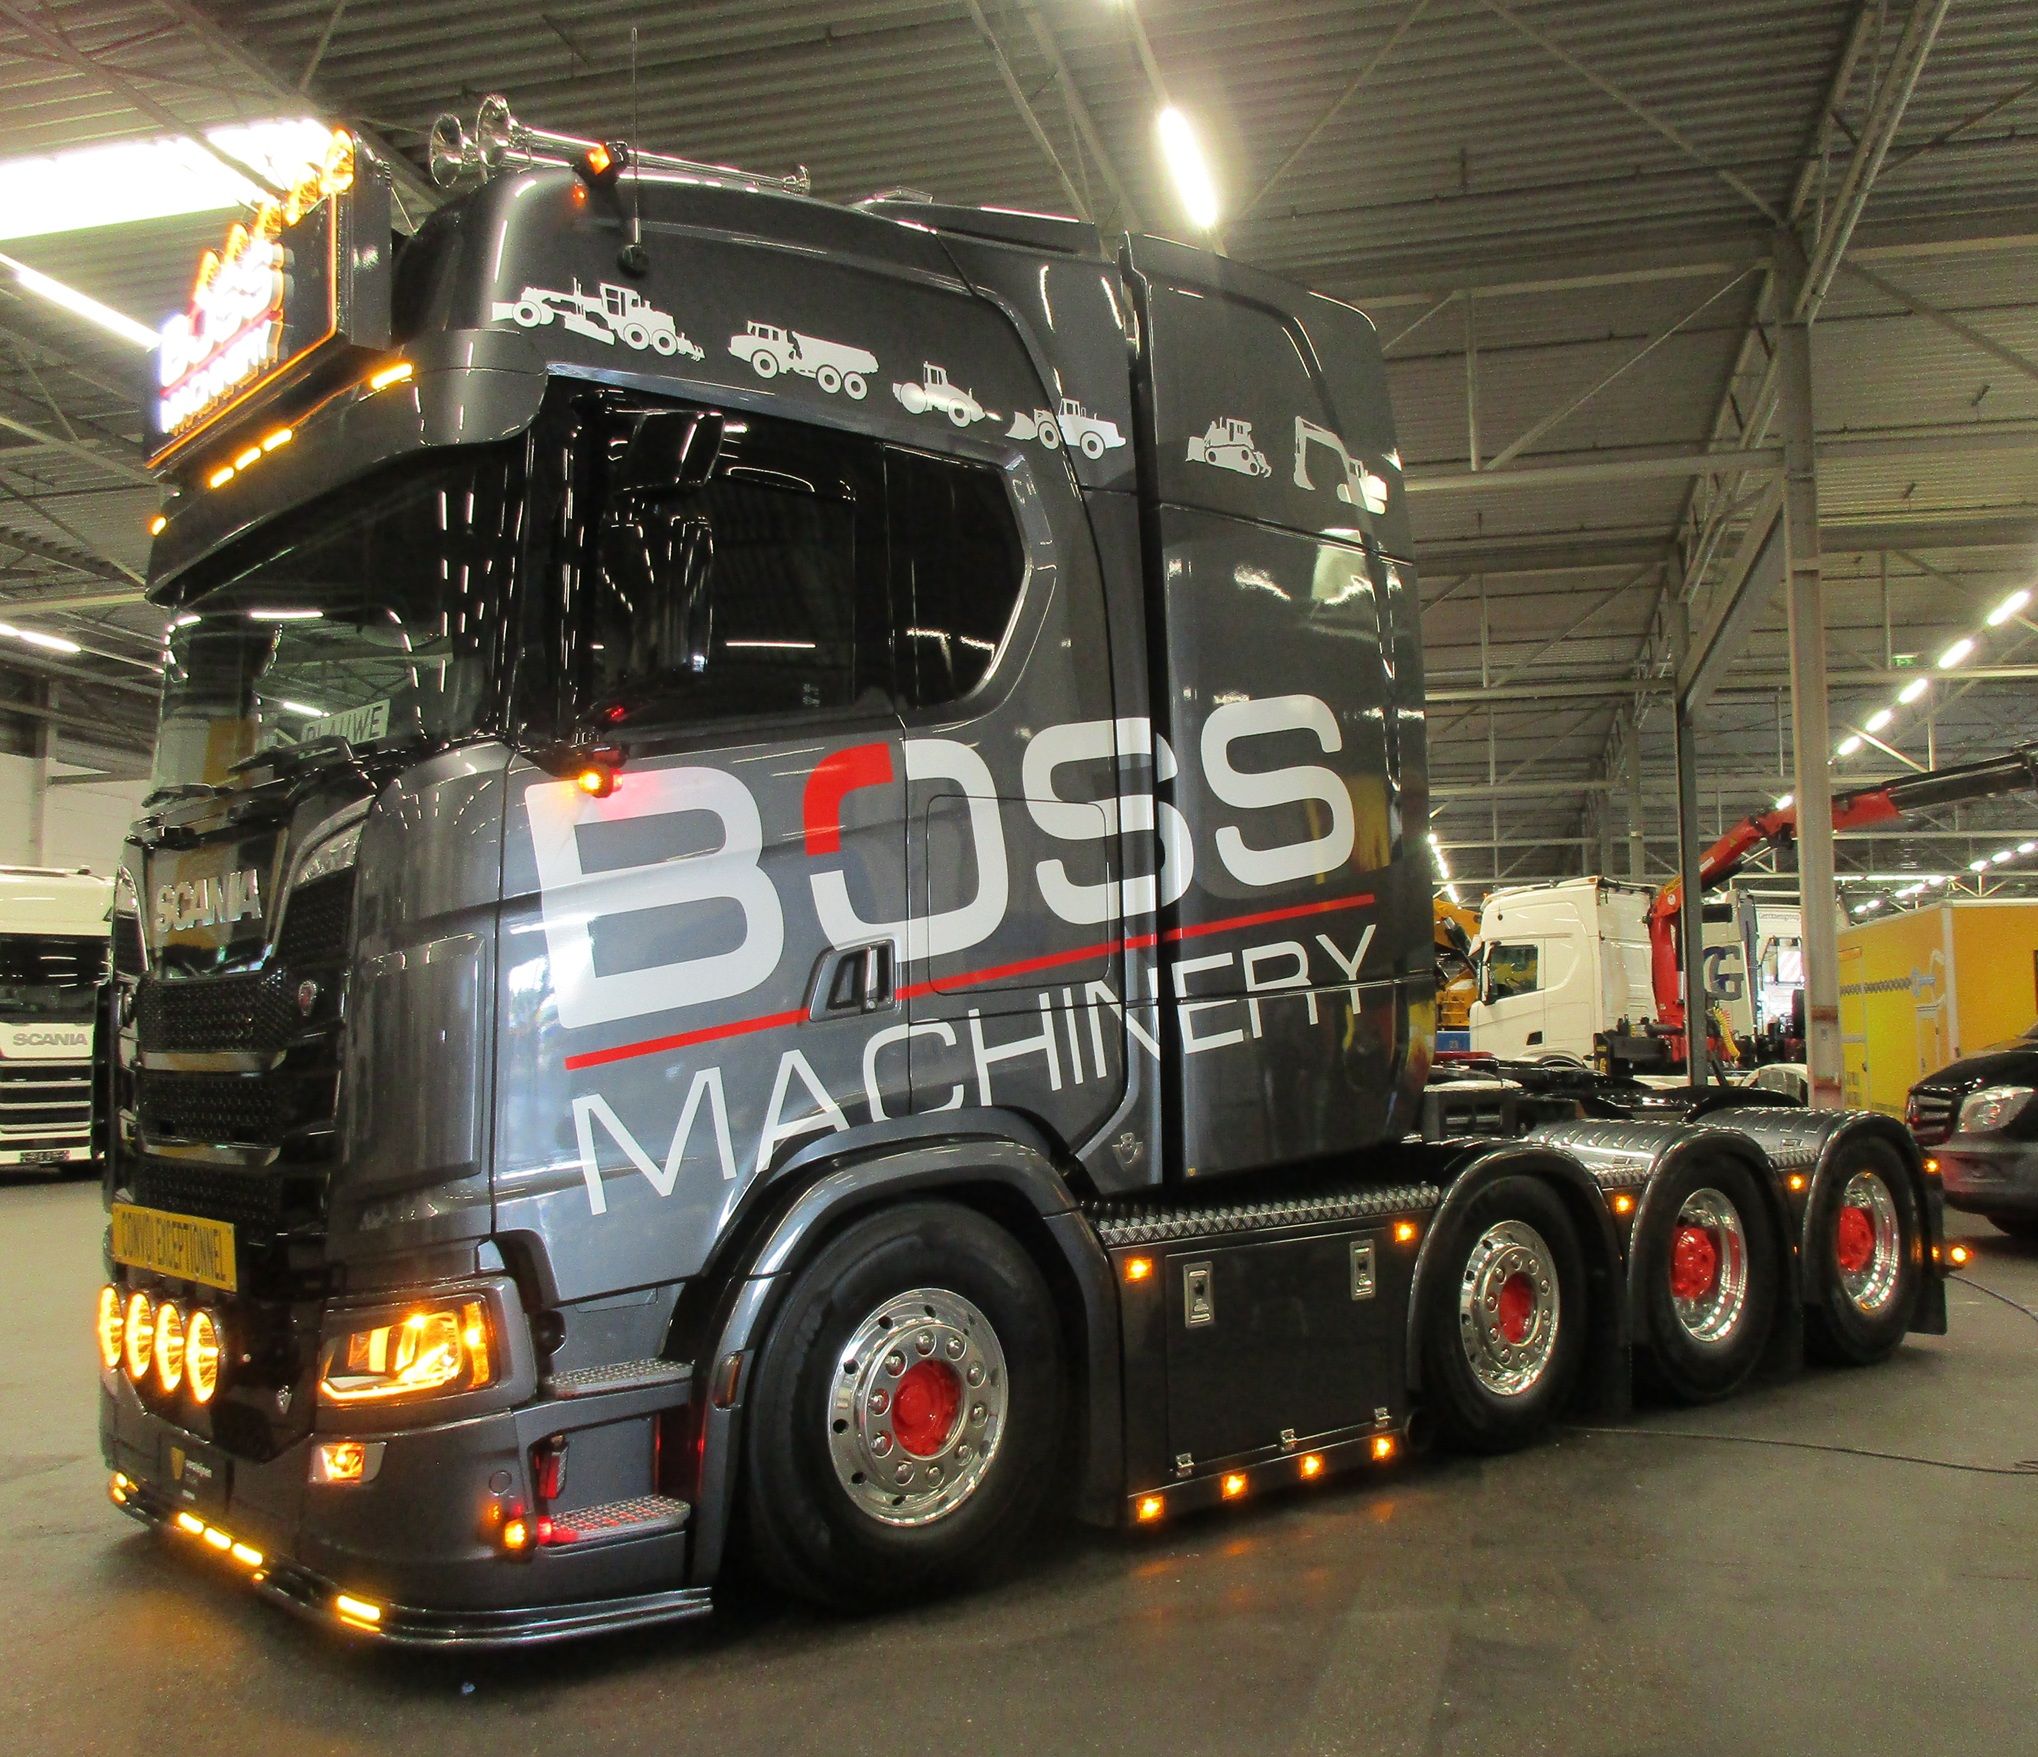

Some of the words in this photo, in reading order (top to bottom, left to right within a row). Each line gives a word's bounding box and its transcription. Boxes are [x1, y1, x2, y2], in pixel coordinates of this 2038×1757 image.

[155, 868, 262, 932] SCANIA
[524, 694, 1355, 1030] BOSS
[12, 1032, 88, 1046] SCANIA
[572, 924, 1377, 1216] MACHINERY
